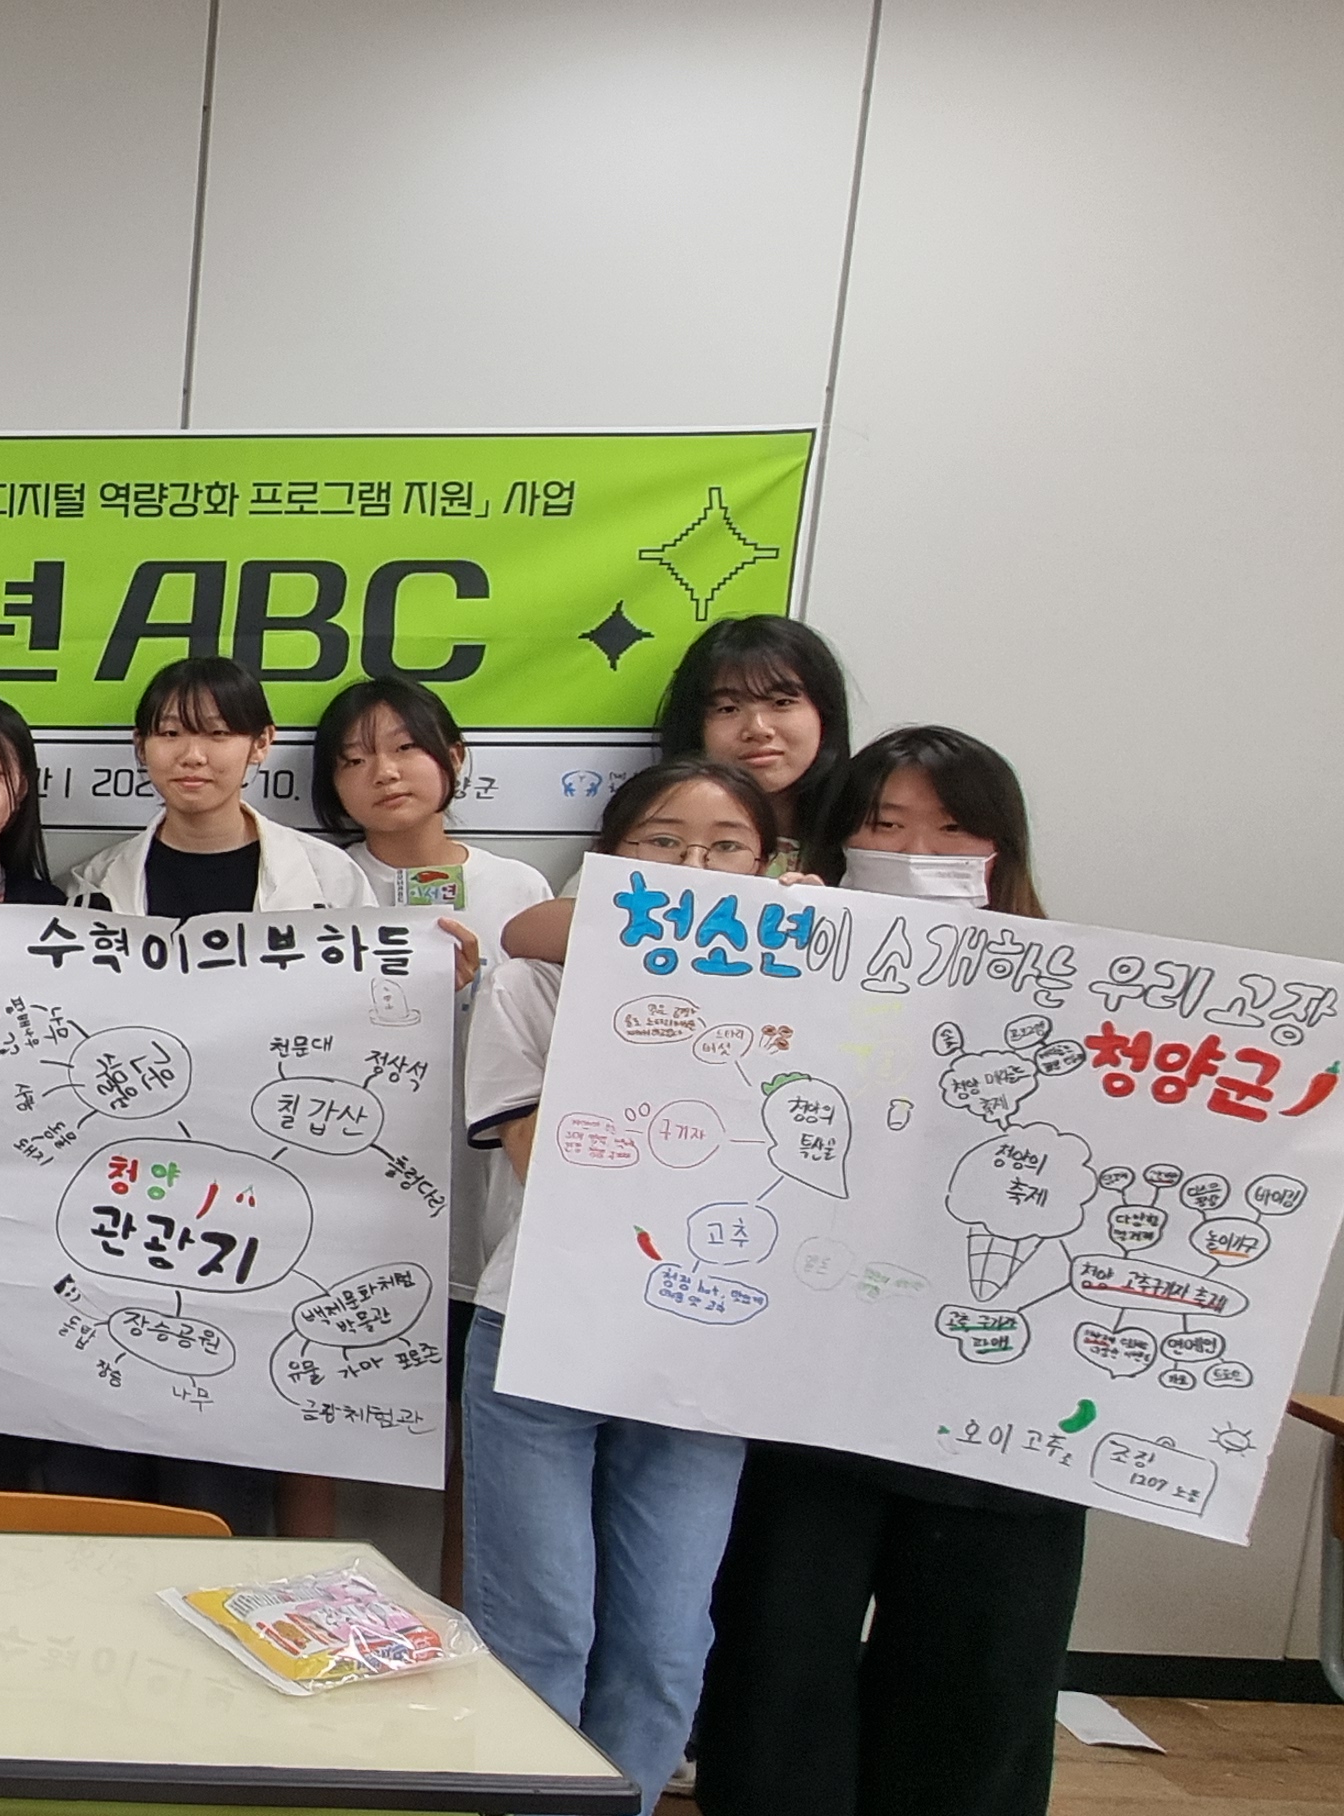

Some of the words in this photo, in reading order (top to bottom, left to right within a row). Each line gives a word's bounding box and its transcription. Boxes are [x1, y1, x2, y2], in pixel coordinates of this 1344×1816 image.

[98, 481, 238, 519] 역량강화
[249, 481, 391, 518] 프로그램
[503, 481, 576, 518] 사업
[95, 559, 491, 683] ABC
[259, 923, 415, 977] 부하들
[614, 870, 853, 984] 청소년이
[861, 915, 1080, 1009] 소개하는
[1088, 955, 1216, 1012] 우리
[1204, 971, 1341, 1048] 고장
[270, 1035, 334, 1058] 천문대
[365, 1050, 429, 1093] 정상석
[1084, 1020, 1293, 1123] 청양군
[278, 1094, 368, 1137] 칠갑산
[659, 1118, 708, 1142] 구기자
[109, 1155, 181, 1201] 청양
[994, 1143, 1048, 1176] 청양의
[1006, 1177, 1049, 1208] 축제
[91, 1204, 260, 1284] 관광지
[707, 1217, 750, 1248] 고추
[1080, 1261, 1115, 1289] 청양
[123, 1311, 221, 1355] 장승공원
[337, 1355, 384, 1380] 가마
[172, 1386, 214, 1412] 나무
[955, 1419, 1013, 1454] 오이
